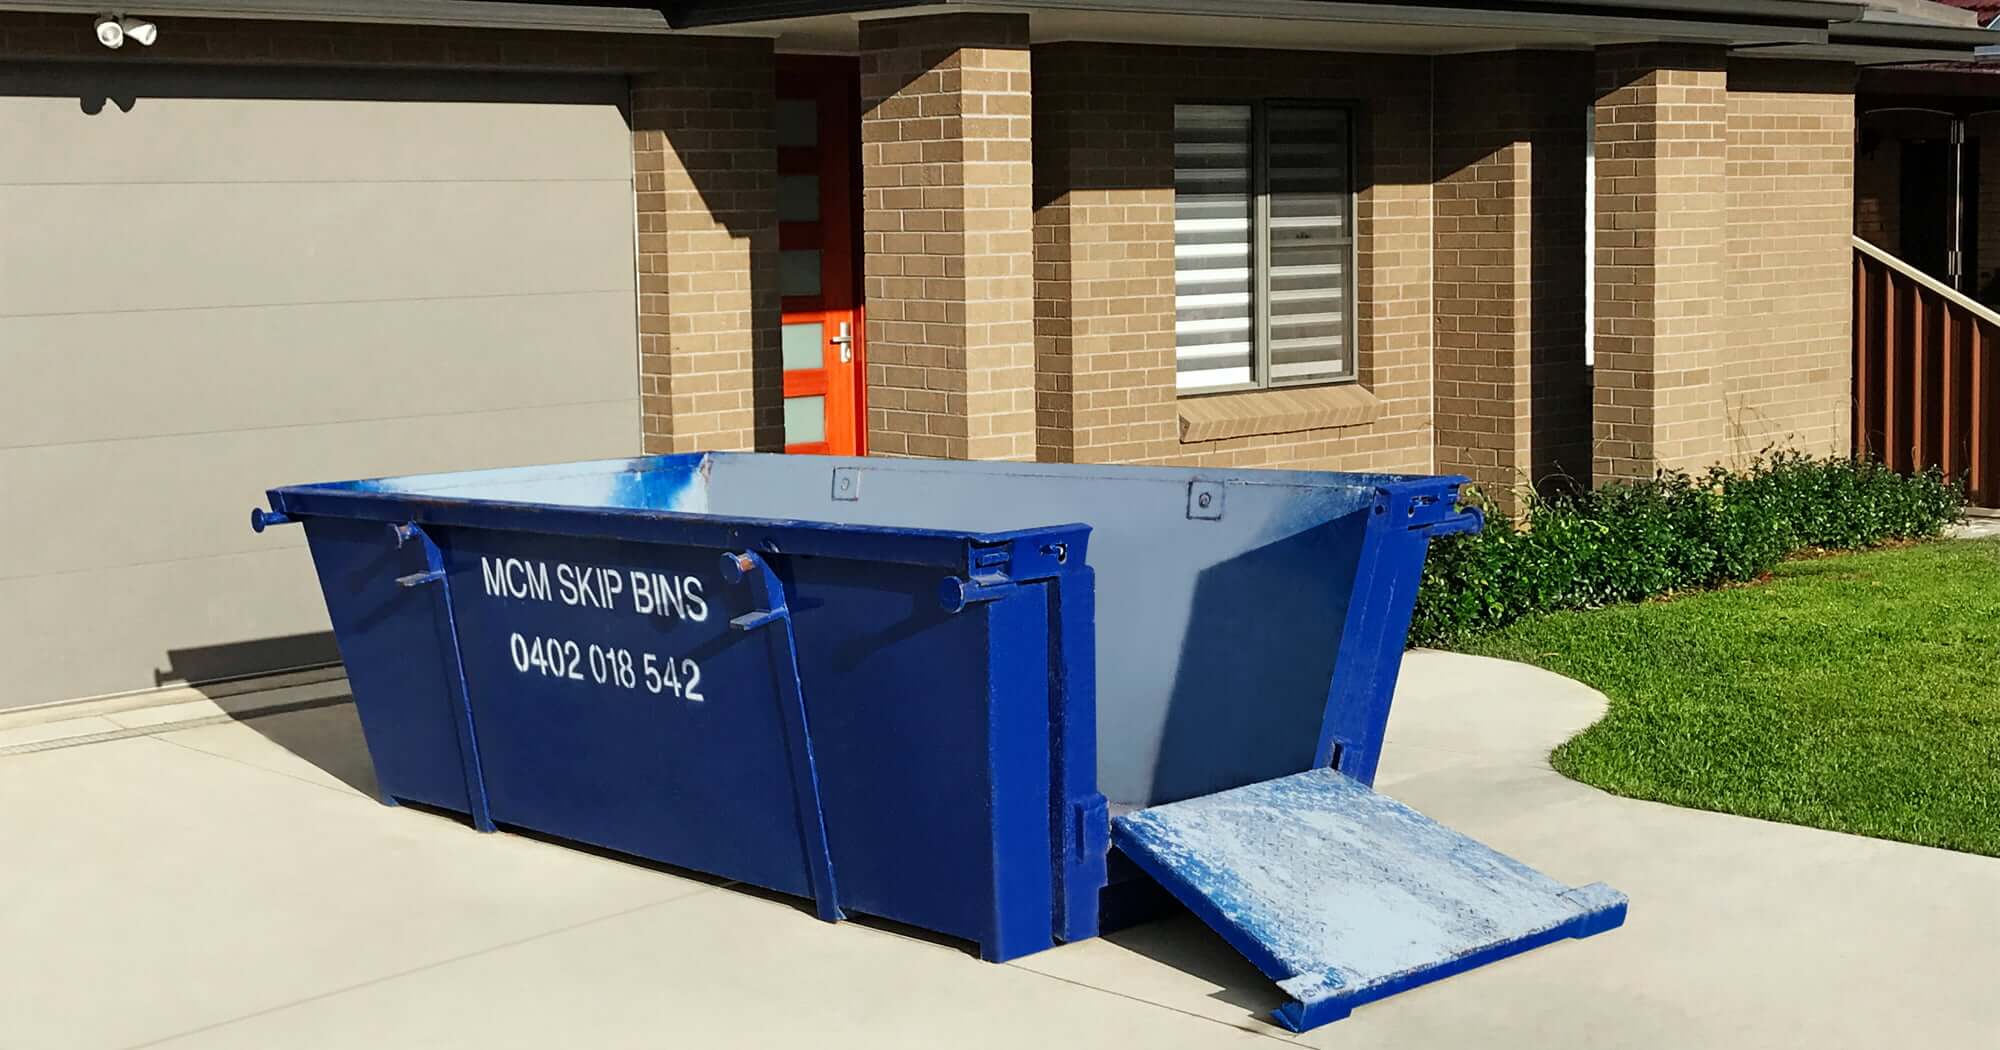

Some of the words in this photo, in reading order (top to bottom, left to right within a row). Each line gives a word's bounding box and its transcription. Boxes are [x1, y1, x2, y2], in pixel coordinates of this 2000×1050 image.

[481, 556, 553, 602] MCM
[556, 563, 623, 609] SKIP
[630, 570, 708, 622] BINS
[510, 632, 585, 681] 0402
[589, 644, 636, 689] 018
[643, 653, 705, 702] 542
